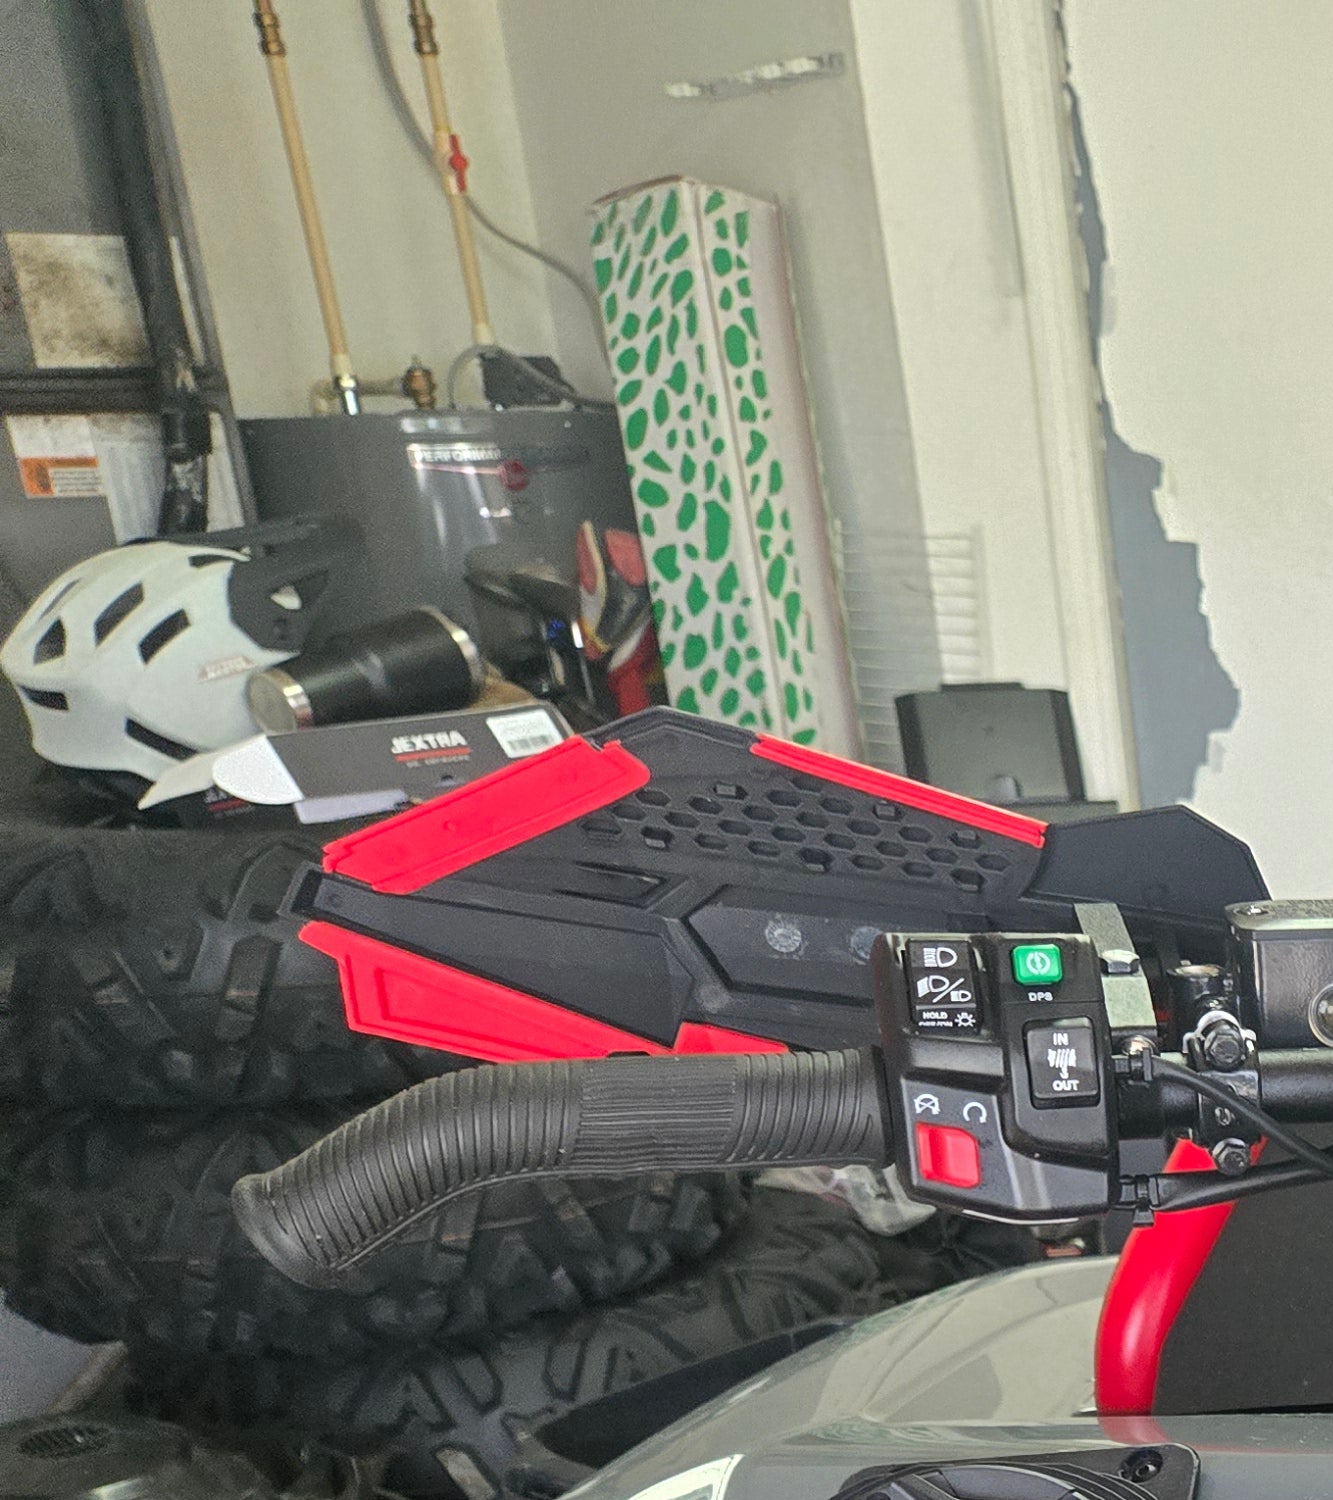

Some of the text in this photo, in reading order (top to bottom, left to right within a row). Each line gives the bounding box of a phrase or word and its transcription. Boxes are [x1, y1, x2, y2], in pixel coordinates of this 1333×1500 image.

[1028, 992, 1053, 1001] DPS
[922, 1011, 948, 1020] HOLD
[1053, 1033, 1069, 1046] IN
[1052, 1080, 1079, 1091] OUT
